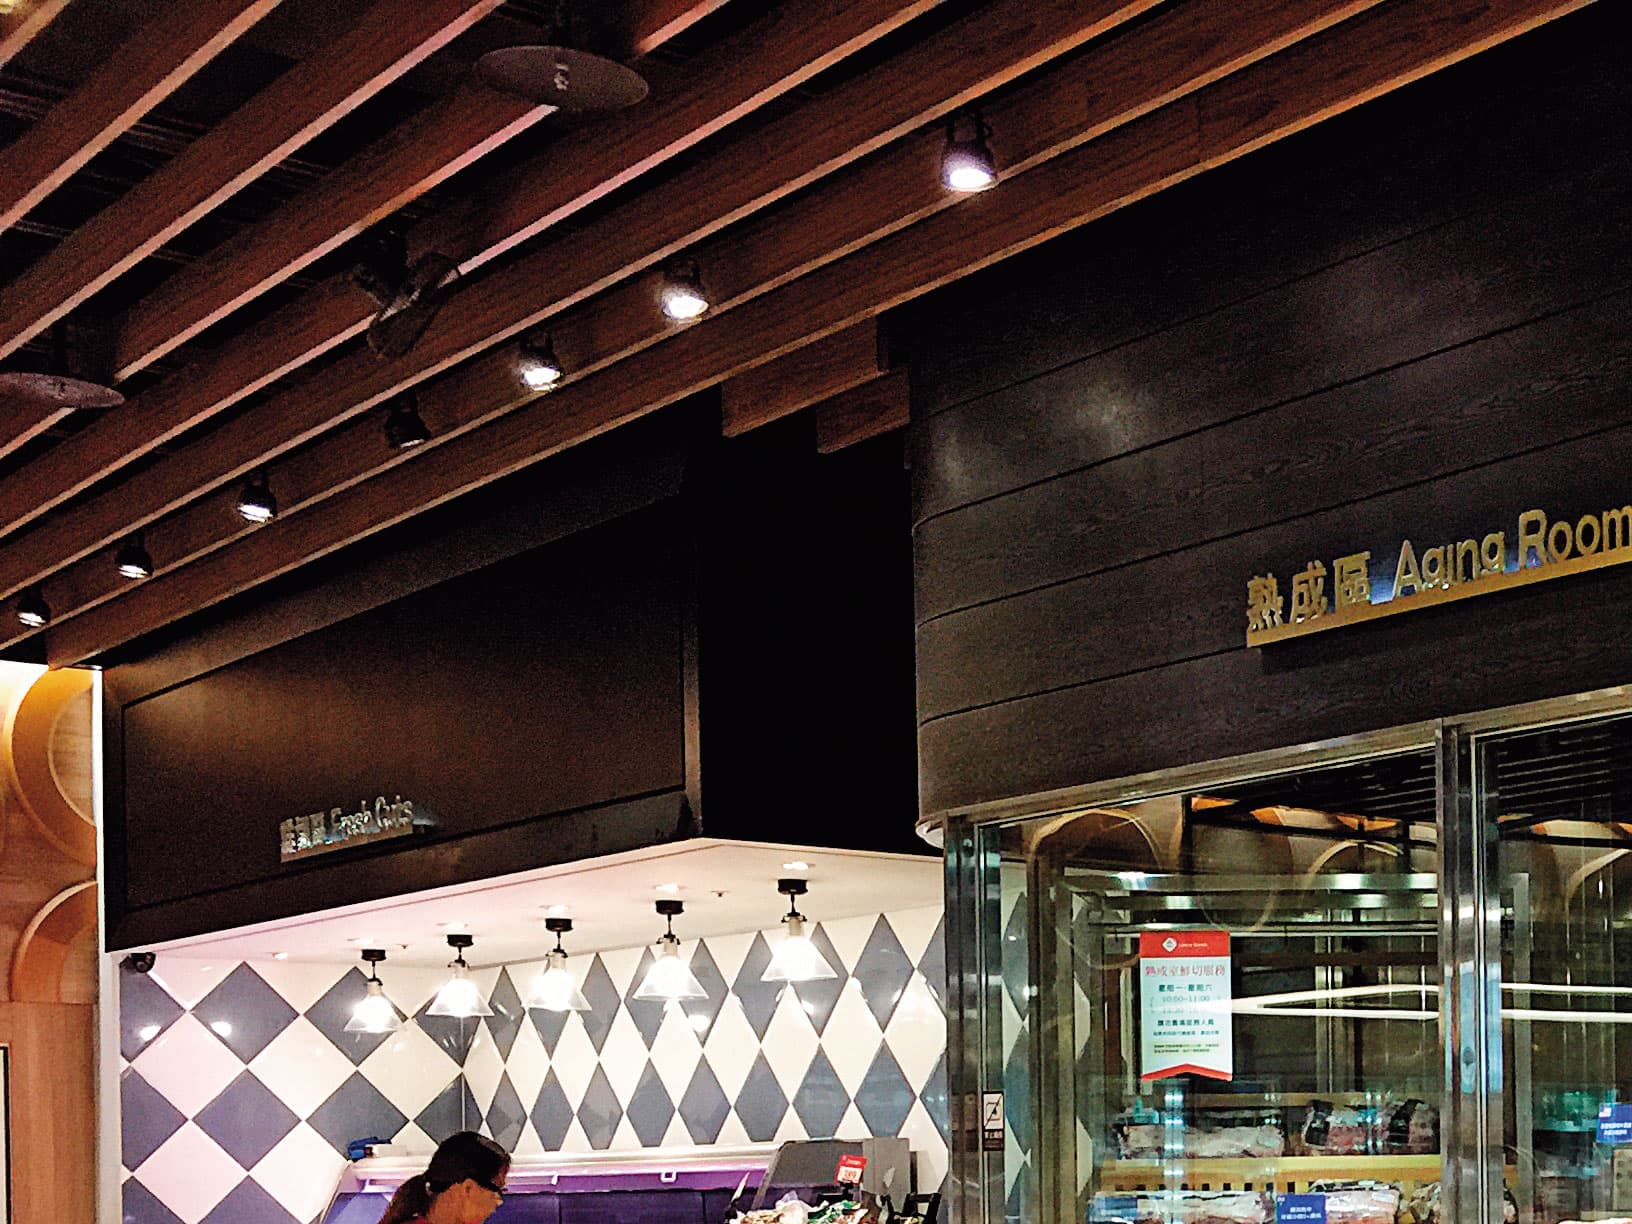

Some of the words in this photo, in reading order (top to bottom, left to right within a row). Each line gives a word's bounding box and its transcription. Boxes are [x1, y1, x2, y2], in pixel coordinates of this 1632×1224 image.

[1246, 551, 1371, 632] 熟成區
[1394, 531, 1505, 600] Aging
